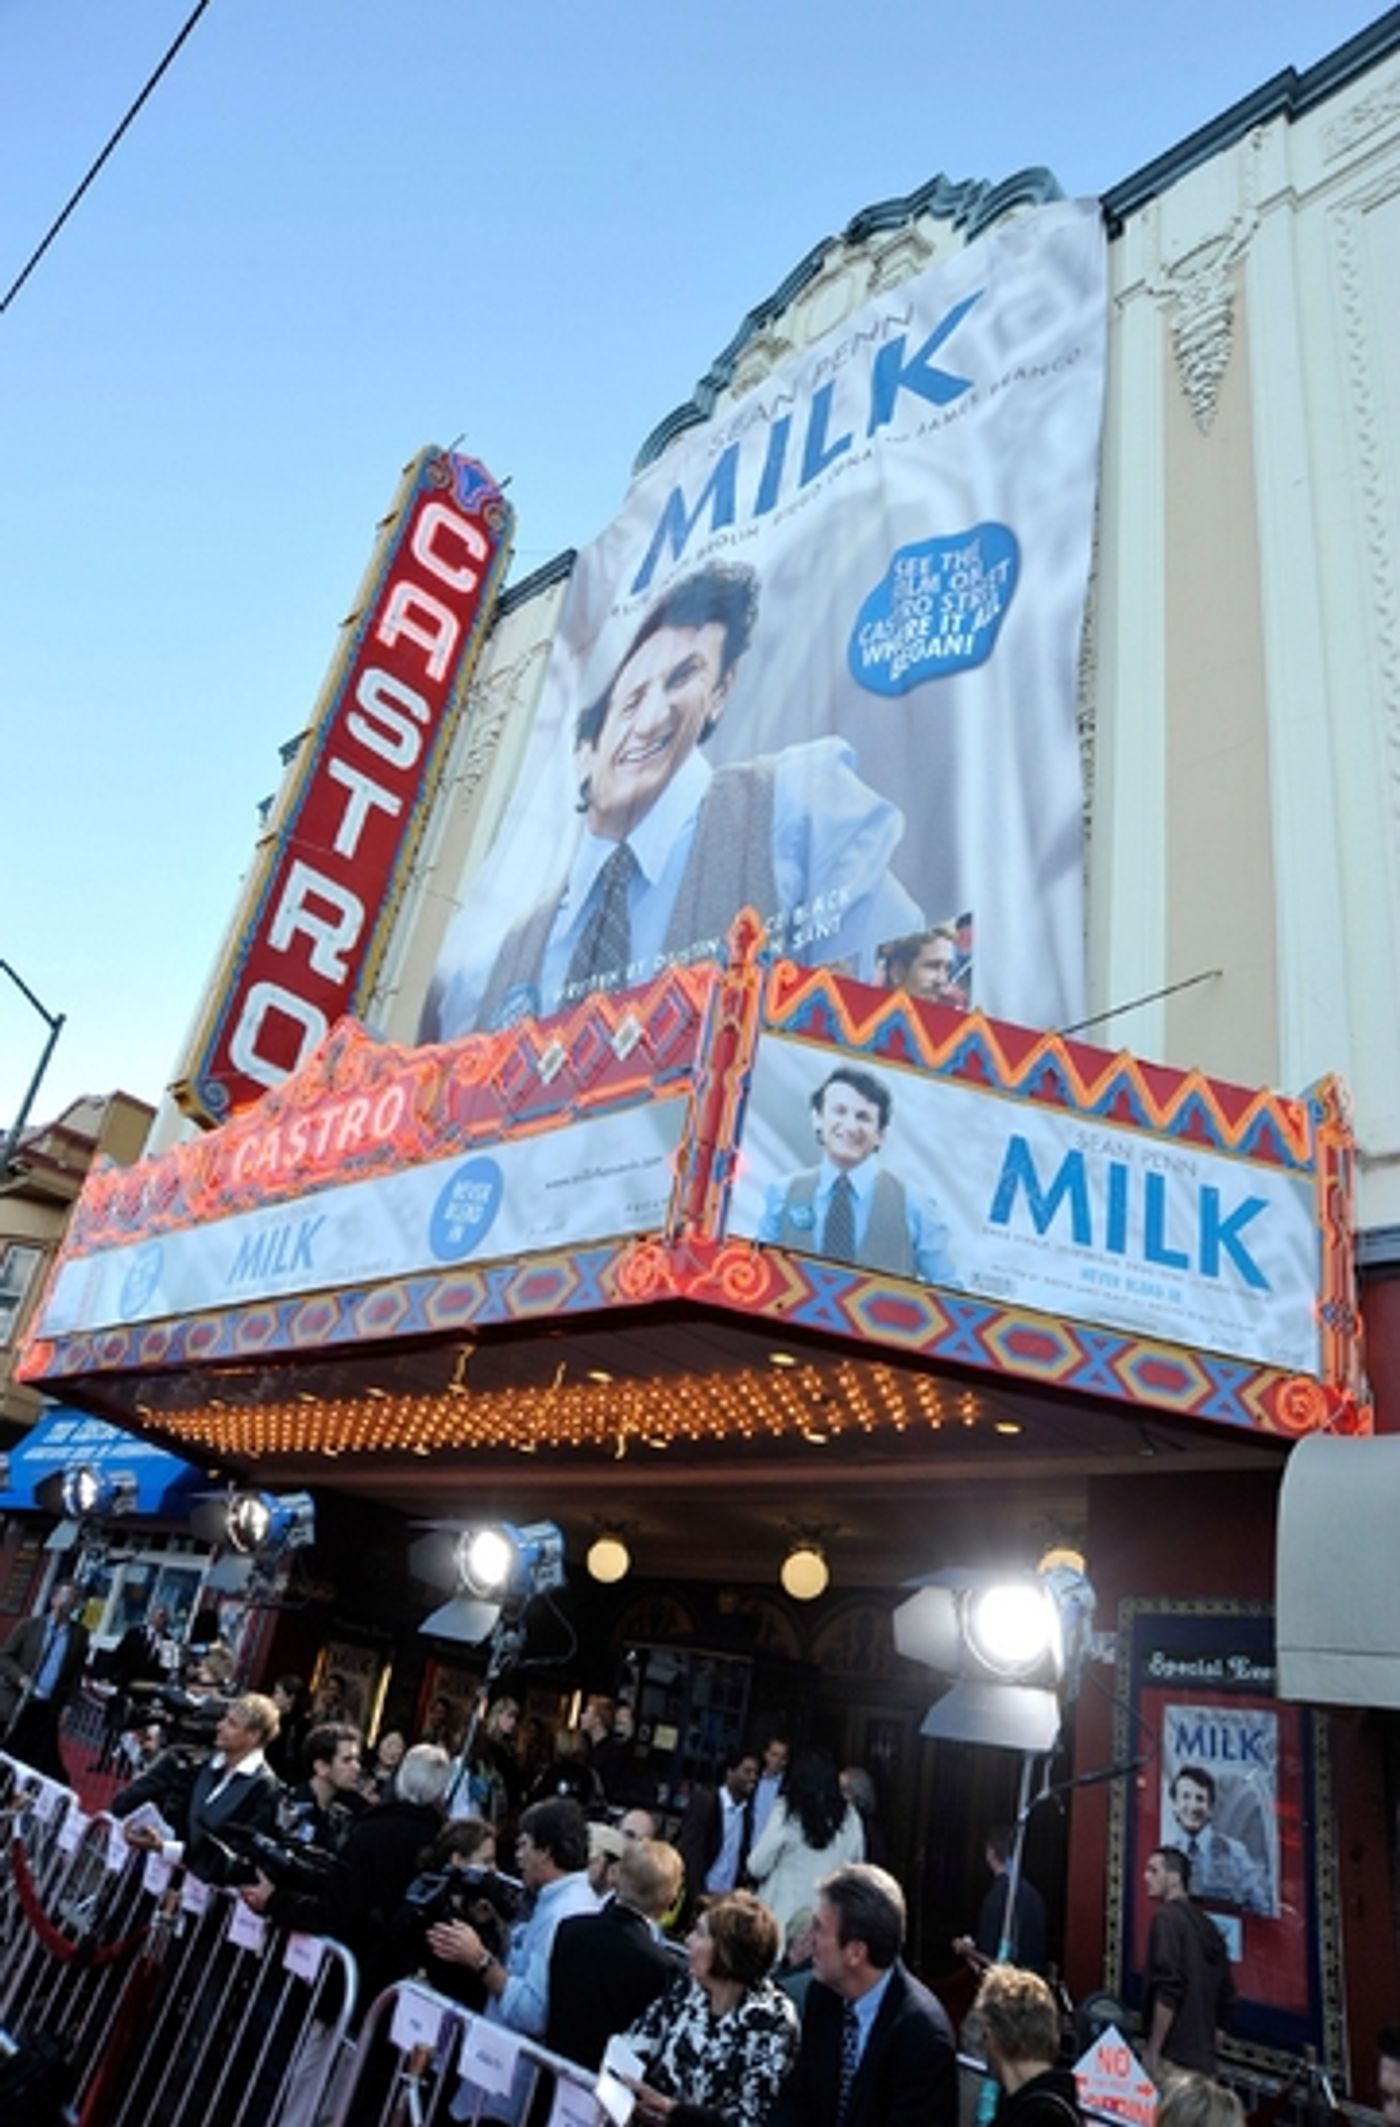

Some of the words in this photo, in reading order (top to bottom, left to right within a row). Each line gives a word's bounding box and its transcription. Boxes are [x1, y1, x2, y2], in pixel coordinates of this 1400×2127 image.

[811, 302, 915, 387] PENN
[631, 288, 987, 597] MILK
[228, 502, 486, 1086] CASTRO
[231, 1085, 404, 1183] CASTRO
[227, 1214, 327, 1286] MILK
[989, 1136, 1270, 1290] MILK
[1148, 1650, 1223, 1679] Special
[1174, 1722, 1270, 1769] MILK
[1096, 2045, 1132, 2079] NO
